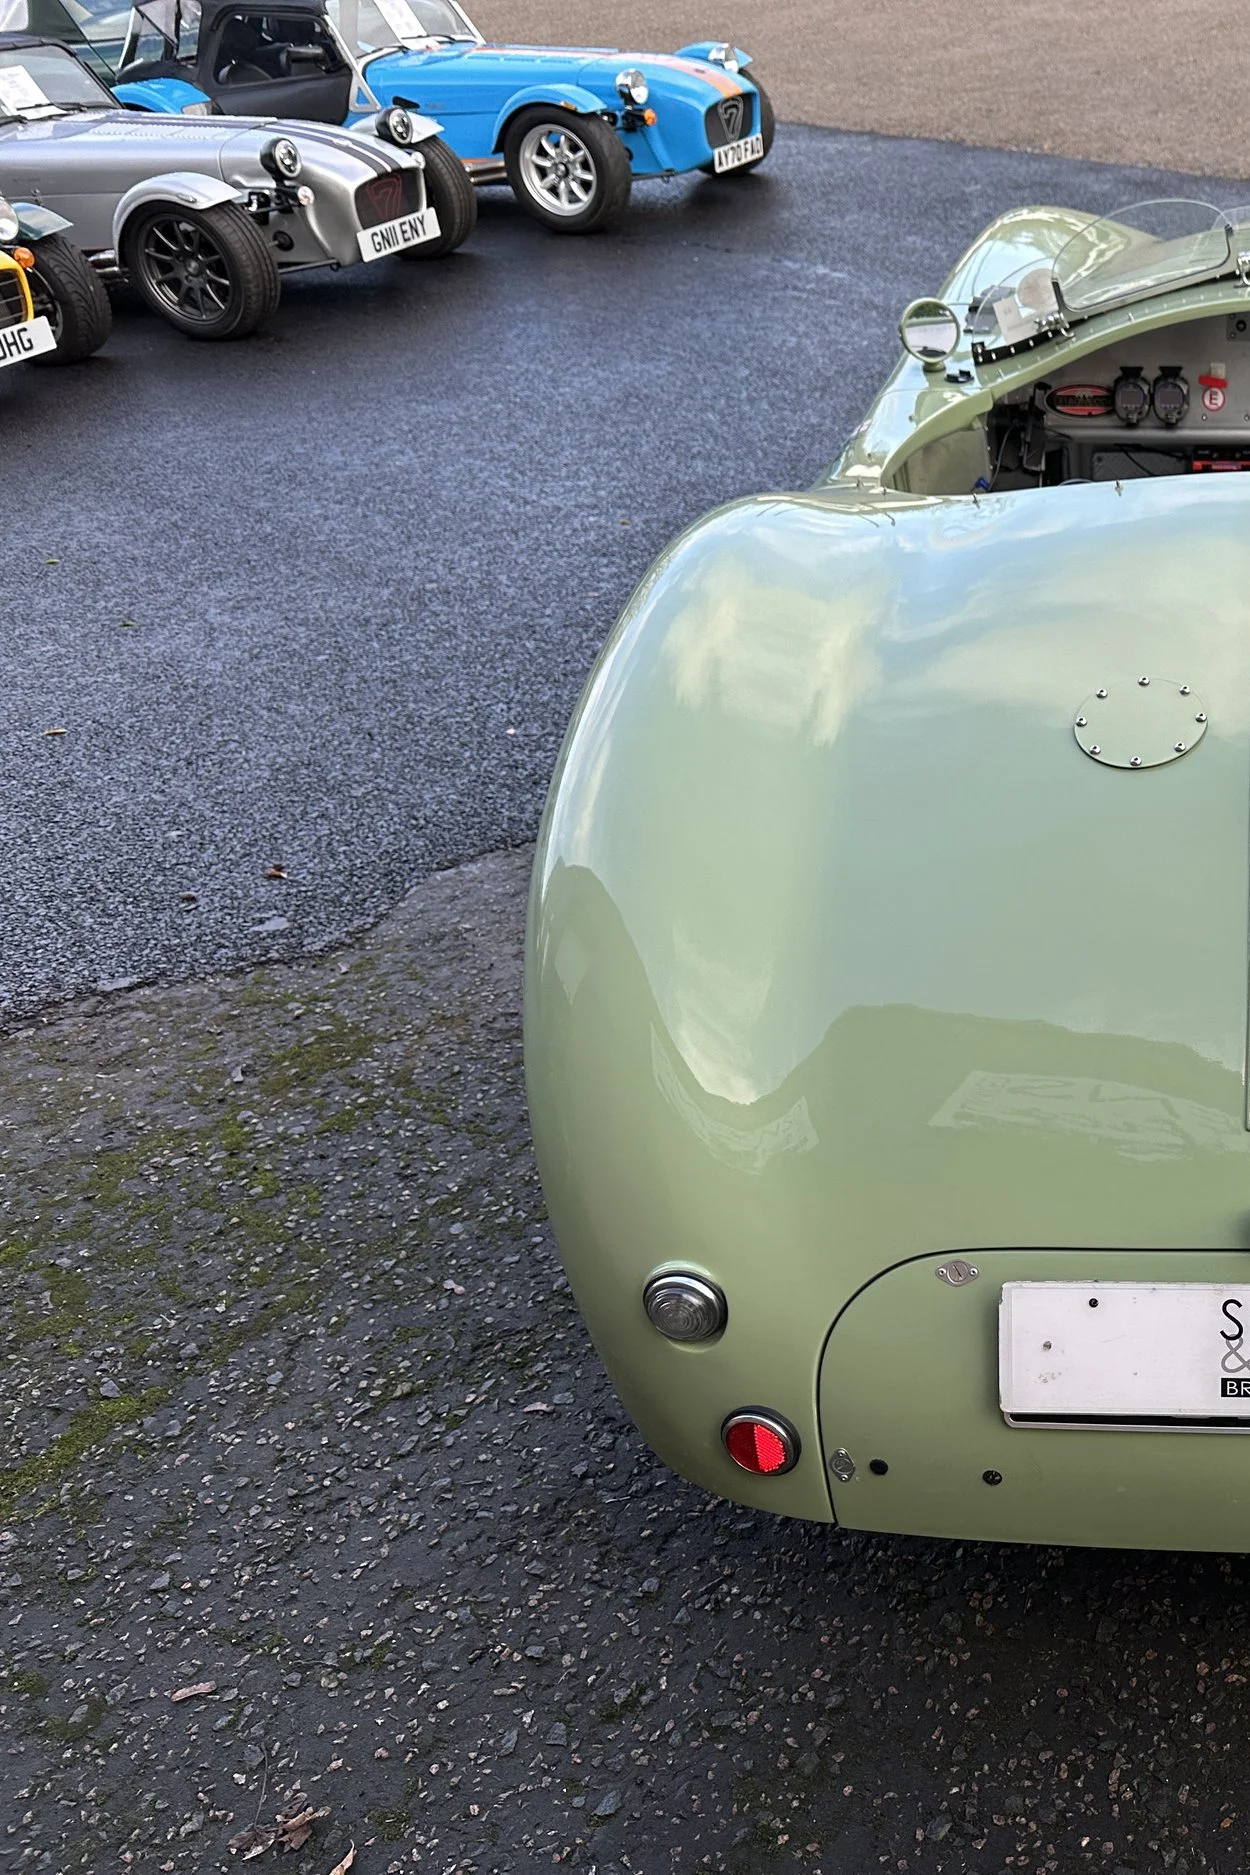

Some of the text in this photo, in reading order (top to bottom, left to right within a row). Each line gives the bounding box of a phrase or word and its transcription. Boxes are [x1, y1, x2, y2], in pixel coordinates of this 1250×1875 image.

[717, 143, 742, 168] AY70
[371, 214, 427, 253] GN11 ENY
[1209, 390, 1219, 406] E
